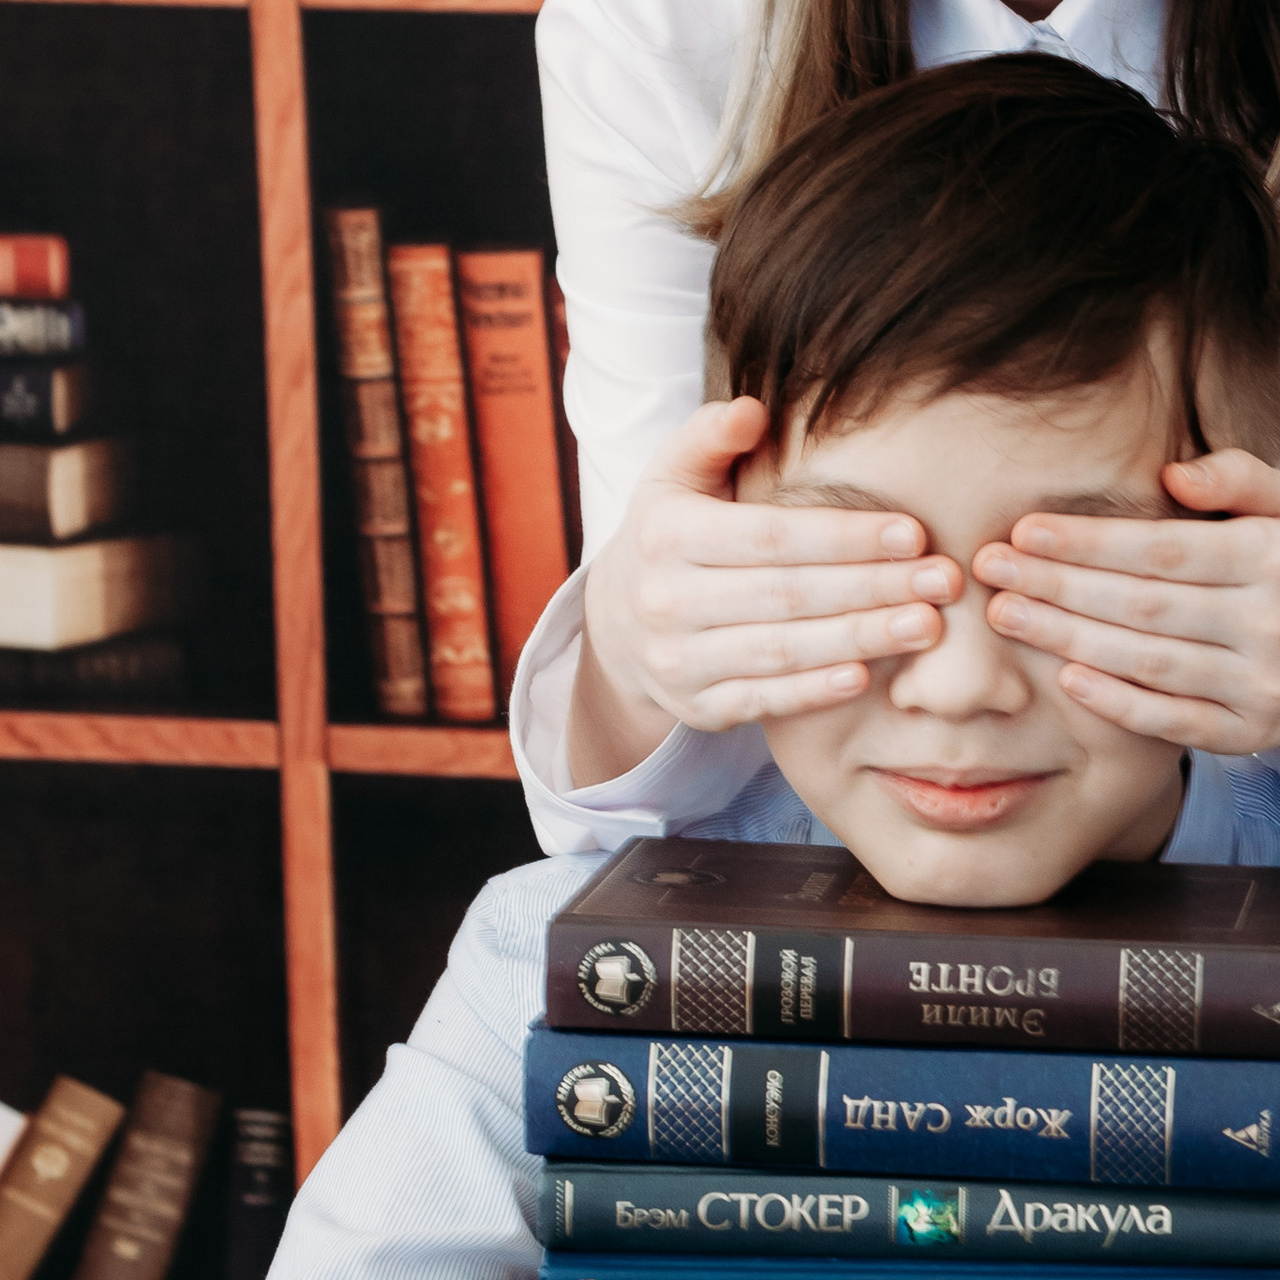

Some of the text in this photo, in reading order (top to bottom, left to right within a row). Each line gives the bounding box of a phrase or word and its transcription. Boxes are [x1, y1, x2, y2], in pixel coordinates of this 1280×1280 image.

[779, 948, 799, 1024] ГРОЗОВОЙ
[799, 955, 817, 1020] ПЕРЕВАЛ
[908, 960, 1060, 999] БРОНТЕ
[842, 1093, 1074, 1139] Жорж САНД
[697, 1190, 870, 1232] СТОКЕР
[986, 1188, 1173, 1249] Дракула
